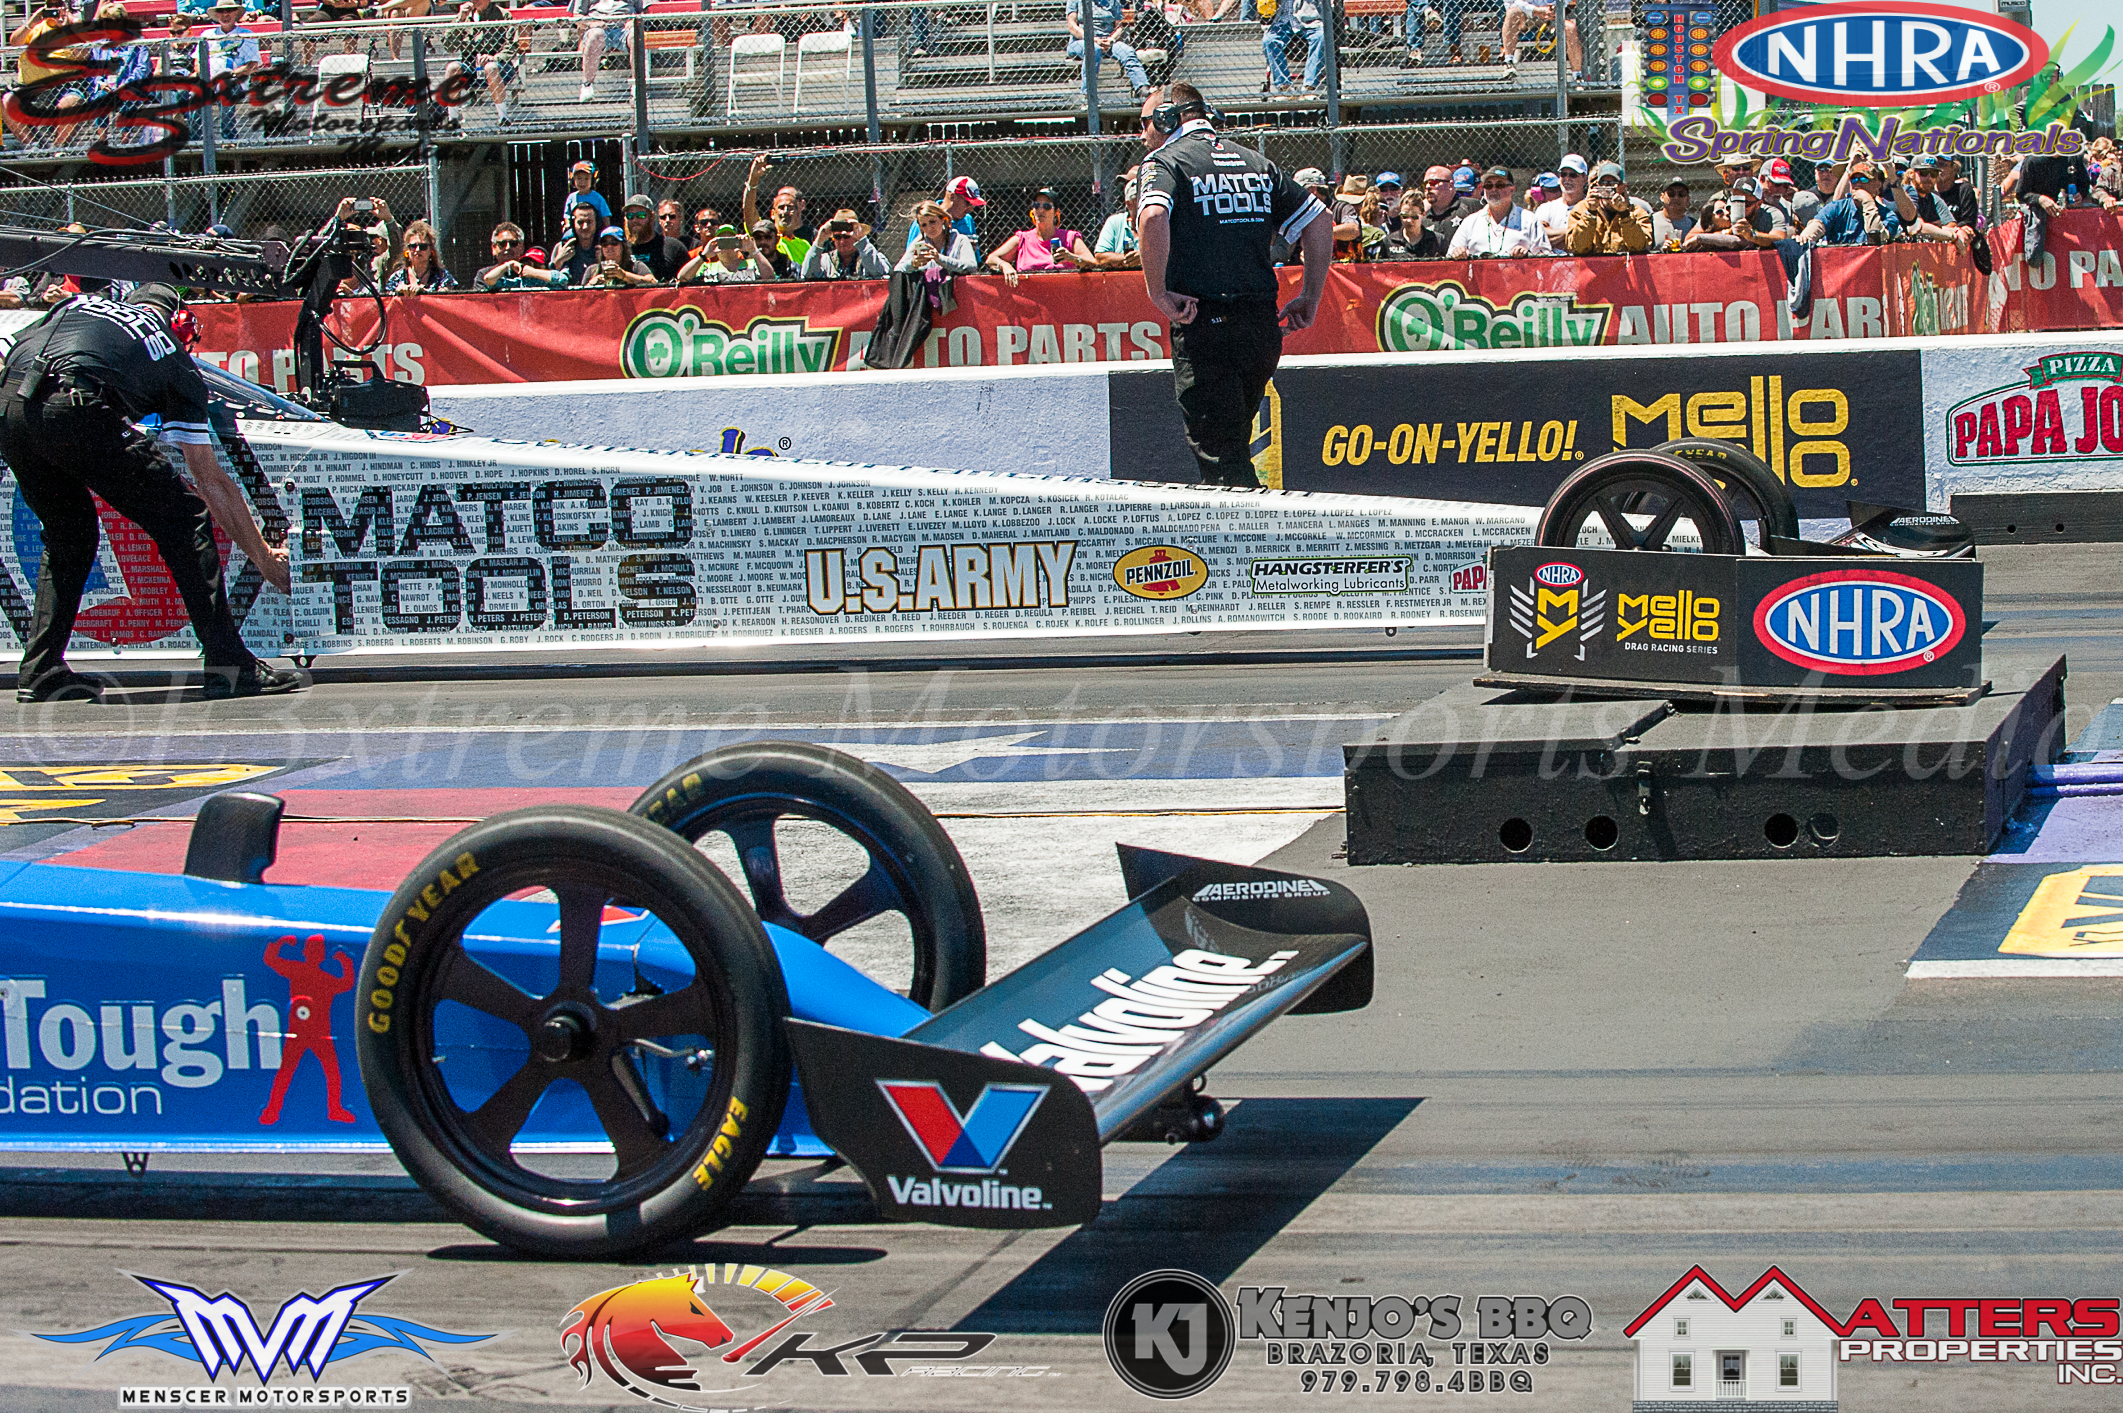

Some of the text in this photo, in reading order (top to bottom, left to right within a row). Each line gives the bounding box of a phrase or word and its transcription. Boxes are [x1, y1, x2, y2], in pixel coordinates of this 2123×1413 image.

[1190, 173, 1273, 196] MATCO
[1194, 193, 1271, 216] TOOLS
[1383, 283, 1606, 352] O'Reilly
[1618, 301, 1762, 347] AUTO
[624, 310, 838, 378] O'Reilly
[997, 320, 1163, 363] PARTS
[2050, 356, 2116, 374] PIZZA
[1955, 388, 2067, 458] PAPA
[1323, 420, 1576, 465] GO-ON-YELLO!
[300, 479, 694, 557] MATCO
[1254, 560, 1404, 576] HANGSTERFER'S
[1542, 565, 1577, 582] NHRA
[300, 553, 696, 637] TOOLS
[1256, 576, 1405, 592] Metalworking Lubricants
[1618, 590, 1720, 619] Mello
[1617, 616, 1720, 642] Yello
[1788, 589, 1932, 655] NHRA
[1624, 641, 1718, 655] DRAG RACING SERIES
[1192, 890, 1331, 902] COMPOSITES GROUP
[1209, 880, 1313, 896] AERODINE
[0, 979, 282, 1088] Tough
[693, 1096, 749, 1191] EAGLE
[887, 1175, 1045, 1210] Valvoline
